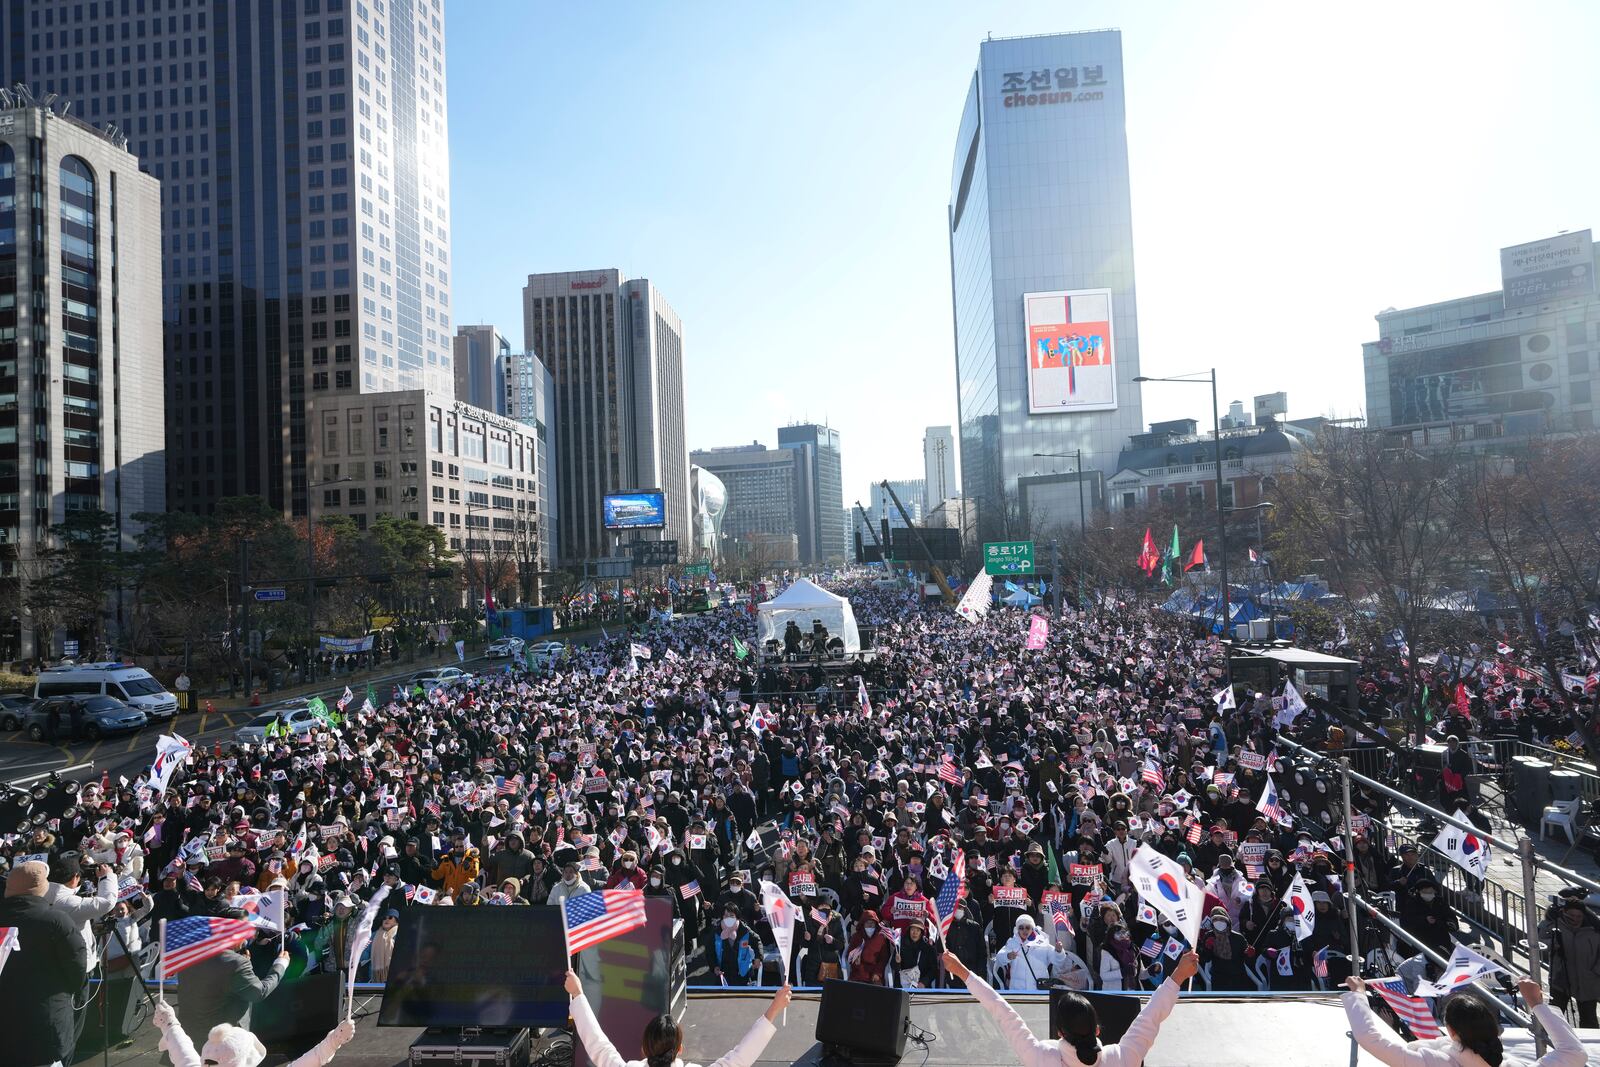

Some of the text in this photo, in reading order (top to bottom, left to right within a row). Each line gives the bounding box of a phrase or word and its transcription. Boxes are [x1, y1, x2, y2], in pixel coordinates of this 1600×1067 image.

[1001, 65, 1107, 93] 조선일보
[1003, 91, 1104, 108] chosun.com
[988, 545, 1028, 556] 종로1가
[1074, 866, 1099, 876] 주사파
[792, 873, 812, 885] 주사파
[997, 889, 1023, 899] 주사파
[897, 903, 922, 911] 이재명
